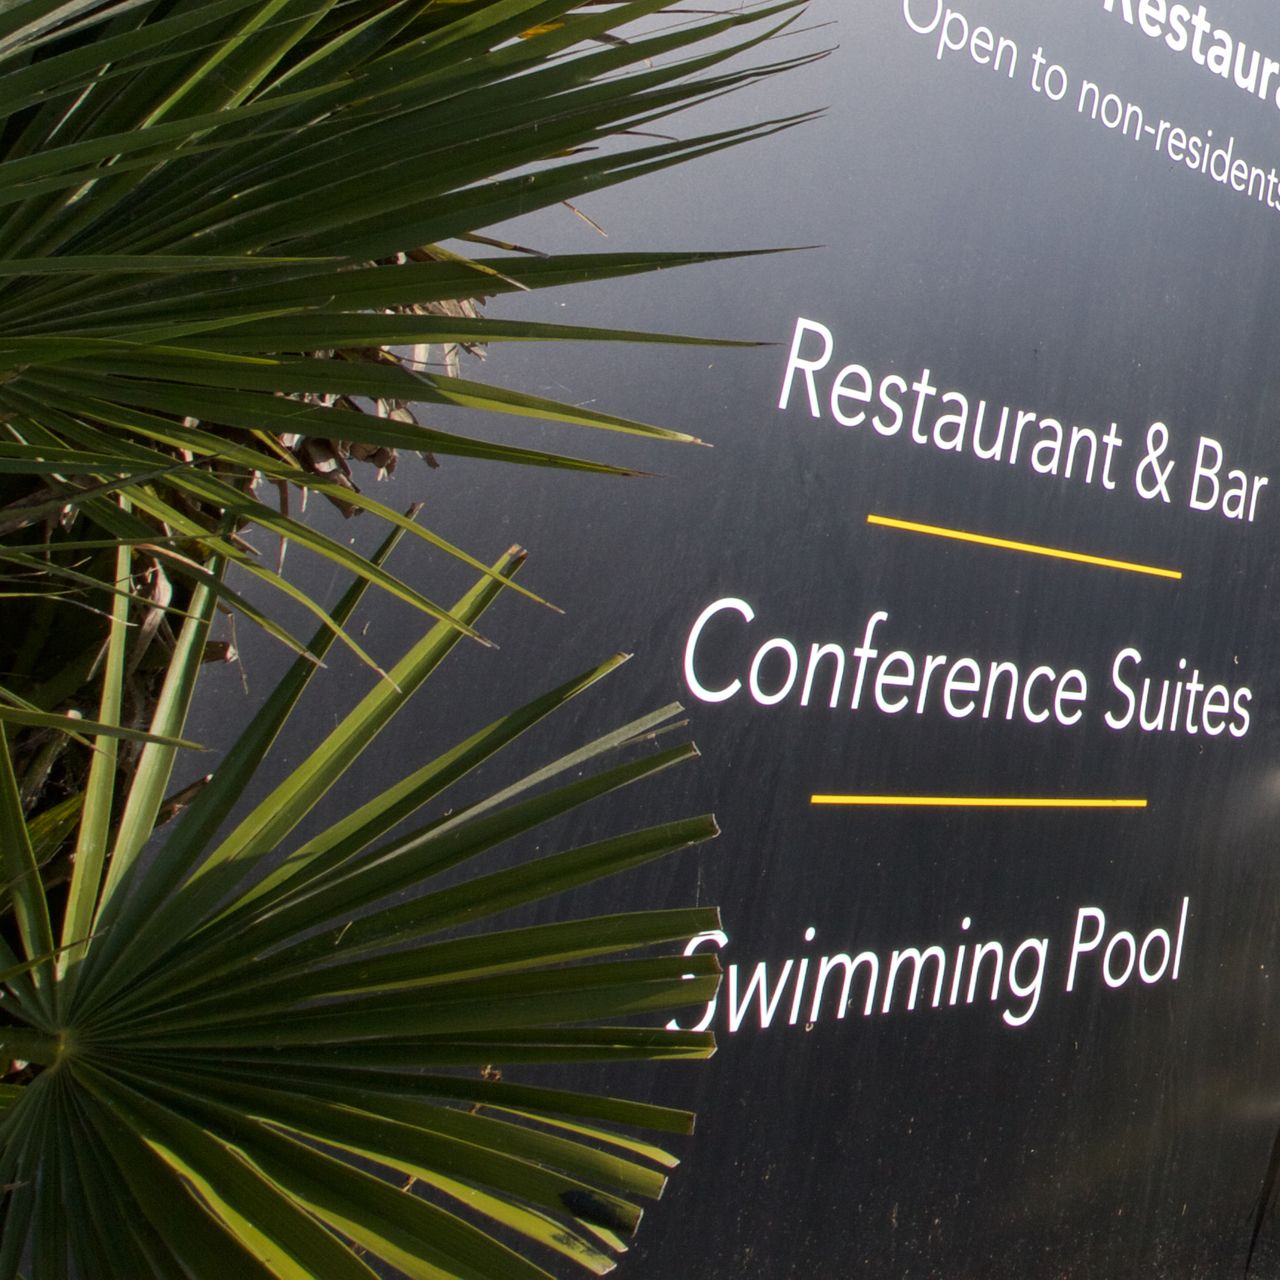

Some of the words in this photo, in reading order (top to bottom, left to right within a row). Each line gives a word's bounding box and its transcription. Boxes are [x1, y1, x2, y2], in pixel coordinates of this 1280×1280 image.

[1030, 46, 1068, 103] to
[777, 316, 1119, 491] Restaurant
[1135, 421, 1176, 504] &
[1189, 435, 1270, 523] Bar
[683, 596, 1089, 727] Conference
[1104, 646, 1253, 739] Suites
[666, 916, 1049, 1033] Swimming
[1066, 896, 1190, 993] Pool
